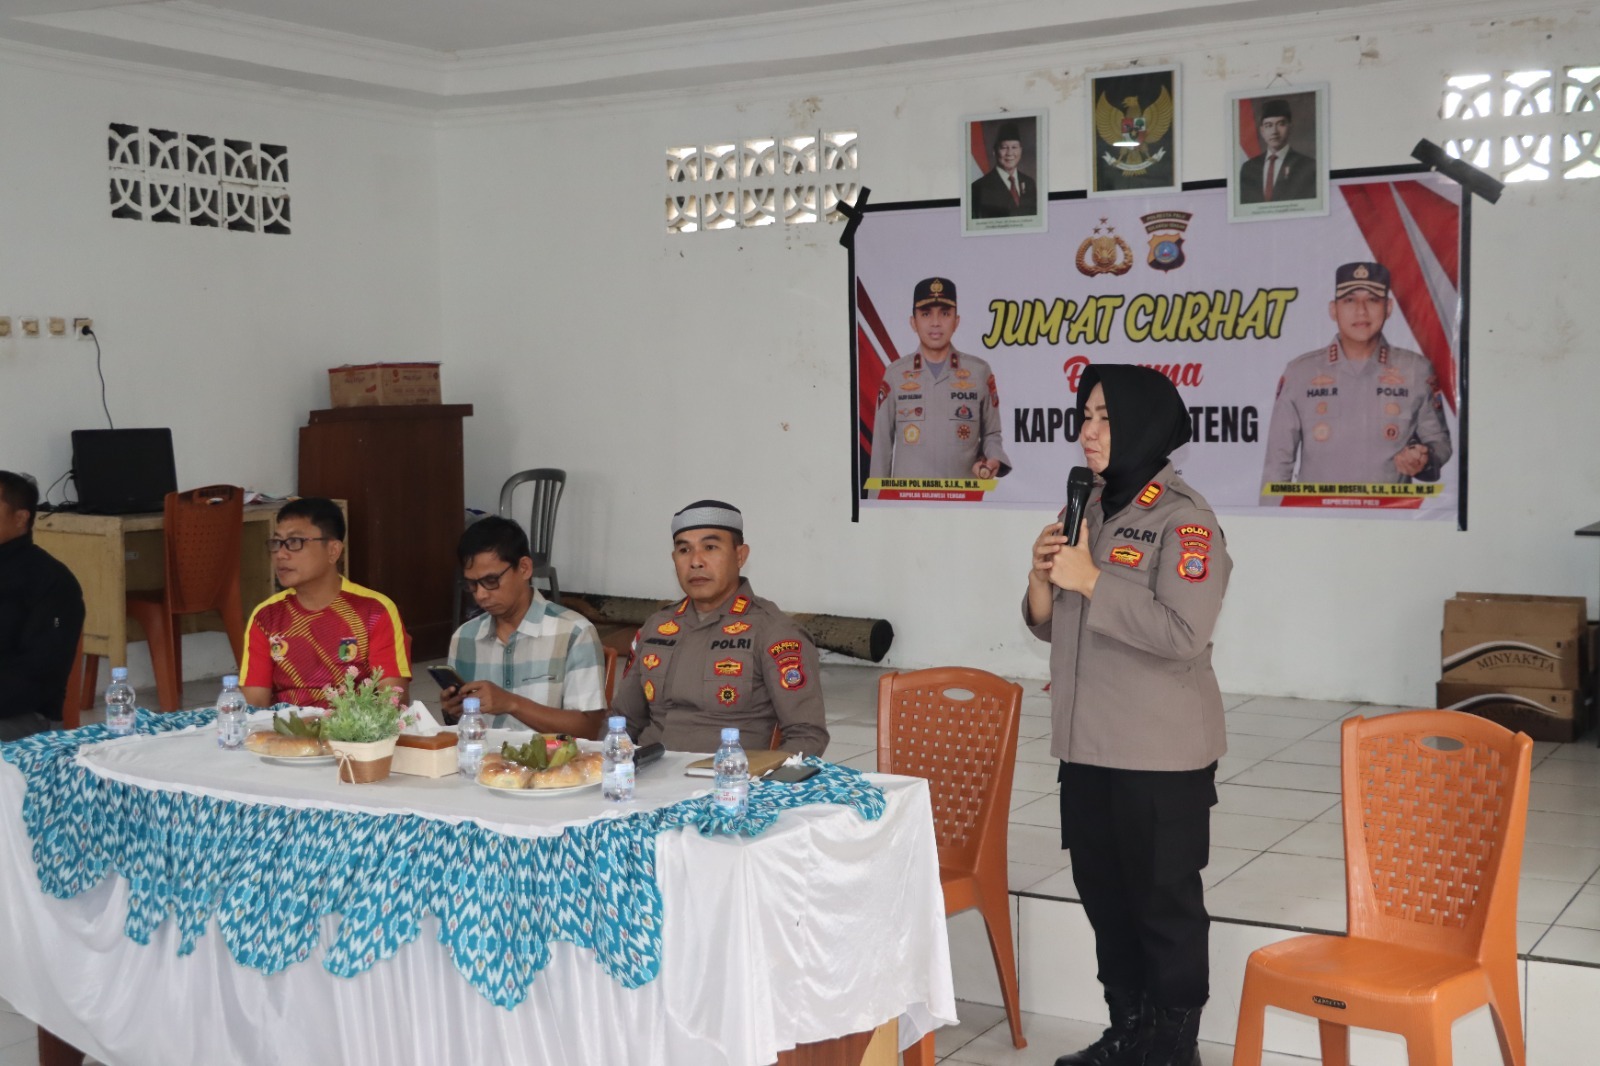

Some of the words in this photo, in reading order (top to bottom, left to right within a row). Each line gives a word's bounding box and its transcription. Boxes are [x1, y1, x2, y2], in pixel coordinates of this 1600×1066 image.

[982, 294, 1124, 349] JUM'AT
[1124, 287, 1298, 343] CURHAT
[950, 392, 978, 400] POLRI
[1376, 387, 1409, 398] POLRI
[1014, 407, 1081, 443] KAPO
[908, 480, 921, 488] POL
[1270, 484, 1301, 493] KOMBES
[1302, 484, 1316, 493] POL
[1318, 484, 1336, 493] HARI
[1113, 527, 1157, 543] POLRI
[1181, 526, 1209, 537] POLDA
[711, 638, 752, 650] POLRI
